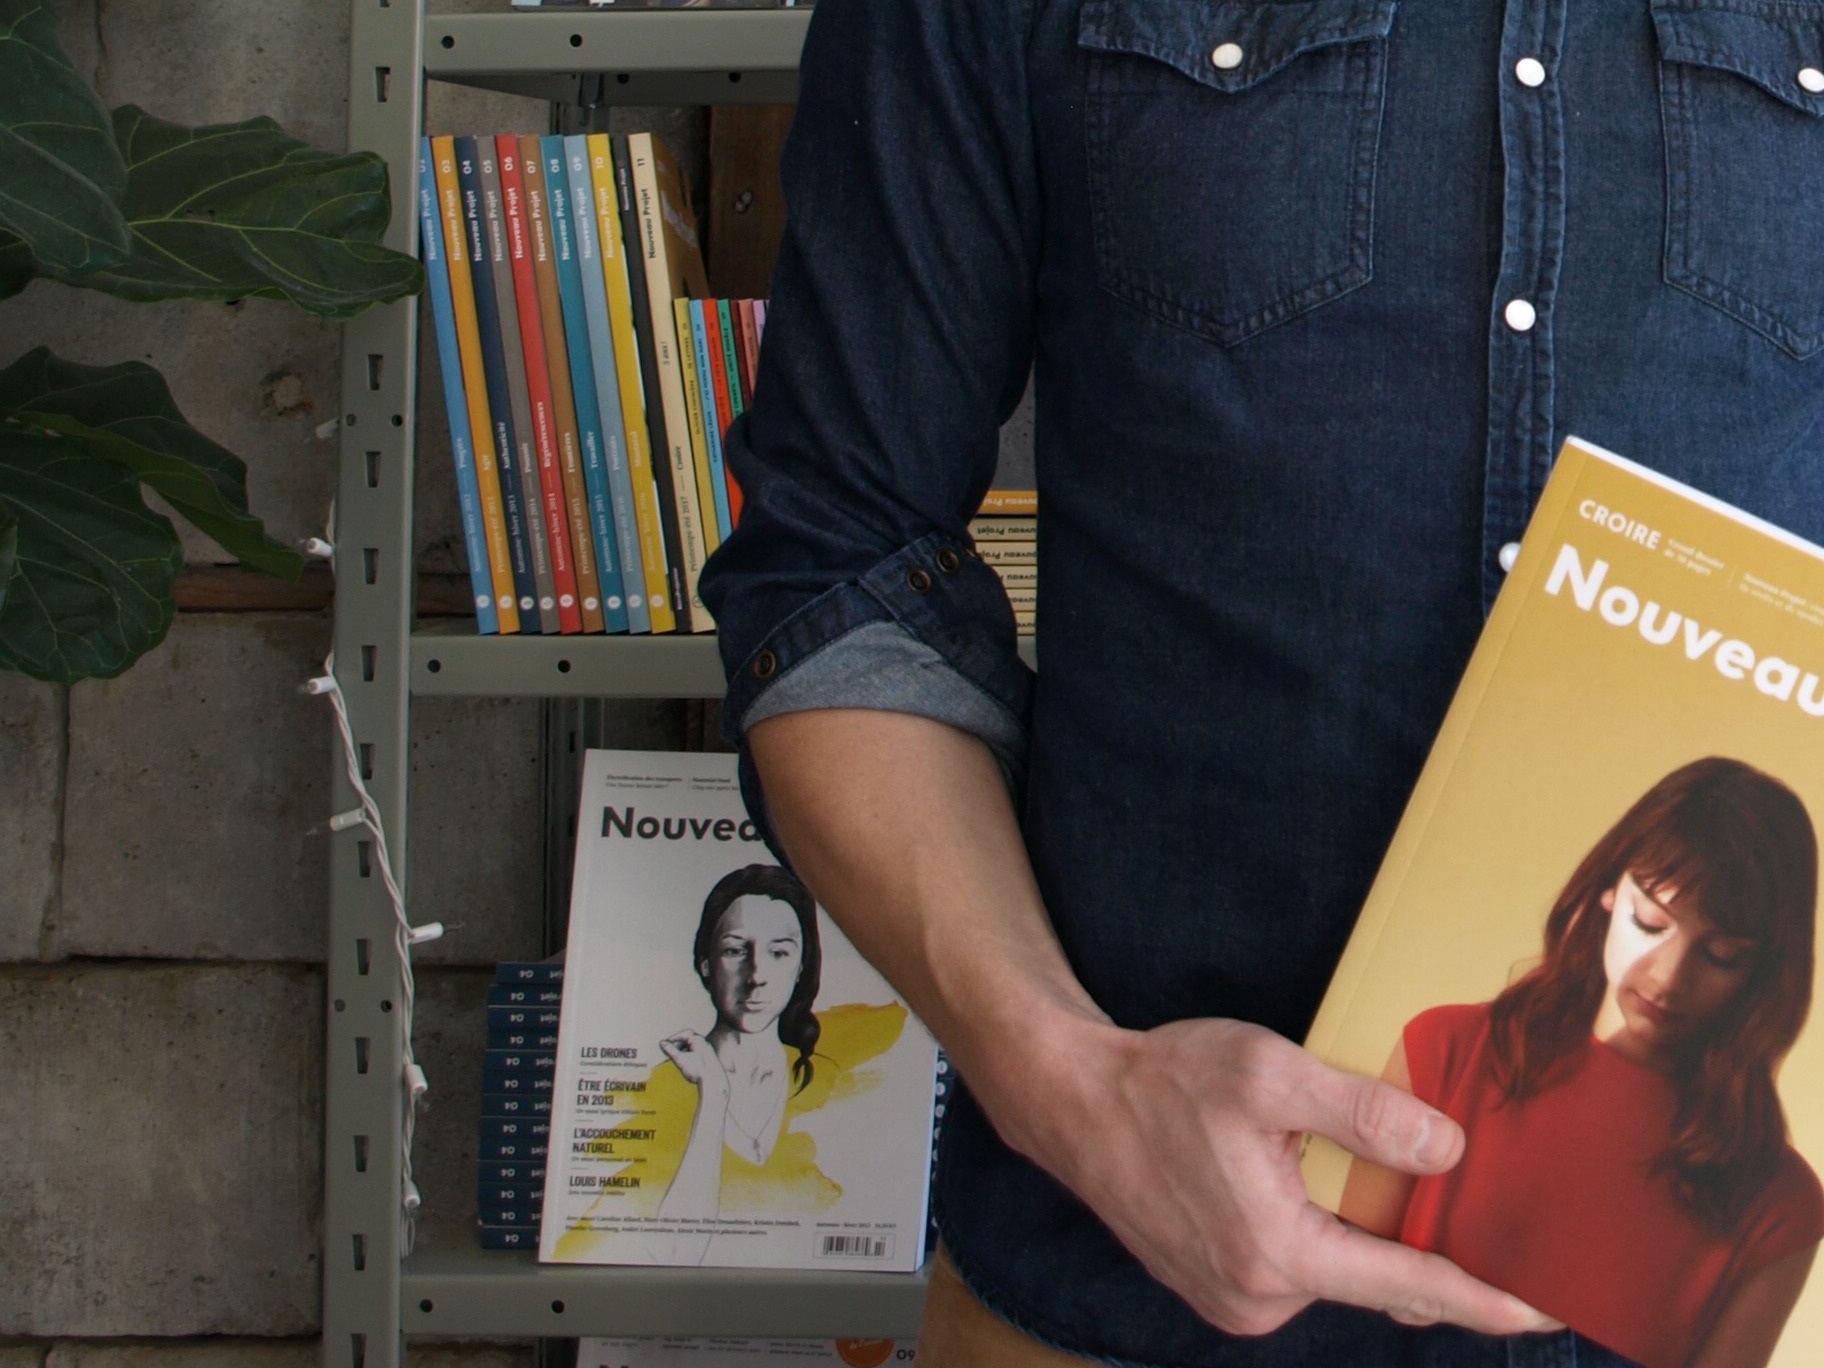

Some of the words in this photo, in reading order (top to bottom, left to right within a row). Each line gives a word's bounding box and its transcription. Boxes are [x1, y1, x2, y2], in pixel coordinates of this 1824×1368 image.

[467, 189, 478, 219] Projet
[508, 187, 519, 216] Projet
[554, 188, 566, 217] Projet
[641, 188, 652, 216] Projet
[472, 220, 483, 262] Nouveau
[513, 217, 525, 259] Nouveau
[559, 219, 572, 261] Nouveau
[645, 218, 657, 259] Nouveau
[1579, 499, 1661, 550] CROIRE
[601, 805, 761, 842] Nouvea
[580, 1047, 599, 1059] LES
[600, 1048, 638, 1060] DRONES
[576, 1094, 590, 1106] EN
[591, 1094, 615, 1106] 2013
[578, 1078, 603, 1092] ÊTRE
[603, 1078, 647, 1093] ÉCRIVAIN
[572, 1141, 615, 1154] NATUREL
[573, 1127, 657, 1141] L'ACCOUCHEMENT
[569, 1175, 597, 1187] LOUIS
[598, 1176, 641, 1188] HAMELIN
[896, 1349, 916, 1362] 09
